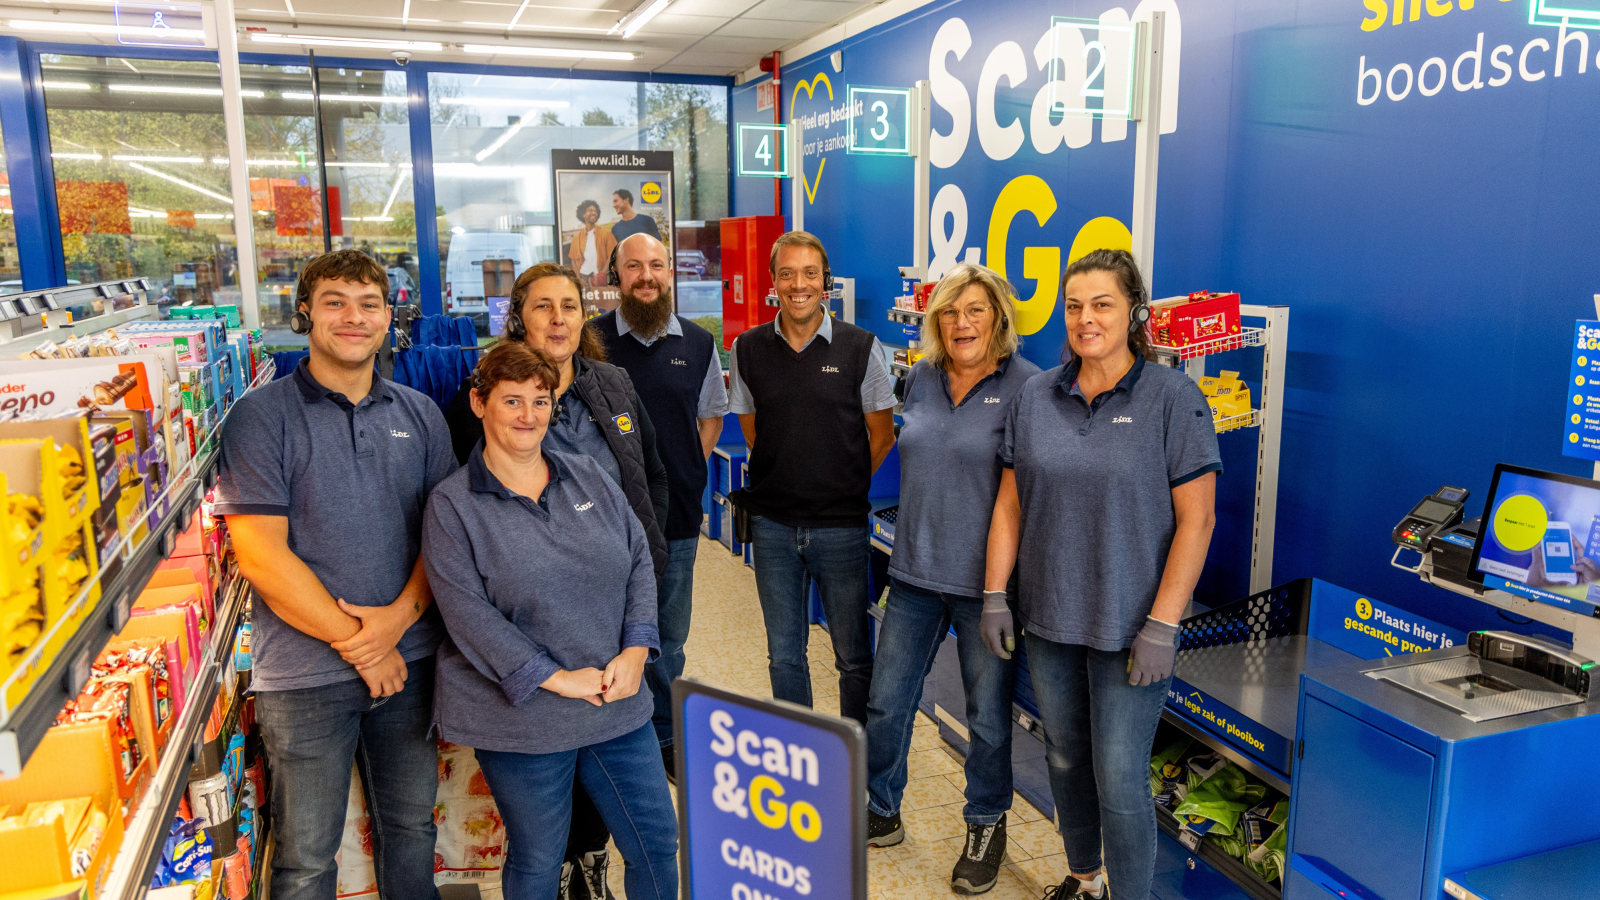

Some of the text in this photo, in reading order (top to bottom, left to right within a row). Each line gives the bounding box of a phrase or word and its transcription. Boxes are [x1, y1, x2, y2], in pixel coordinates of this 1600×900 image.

[929, 0, 1181, 168] Scan
[1080, 41, 1107, 97] 2
[801, 111, 817, 130] Heel
[818, 111, 830, 129] erg
[870, 101, 889, 141] 3
[579, 154, 646, 167] www.lidl.be
[755, 135, 771, 166] 4
[817, 138, 824, 157] je
[0, 383, 26, 394] der
[1344, 617, 1399, 646] gescande
[1360, 603, 1454, 649] 3. Plaats hier je
[1176, 692, 1184, 703] je
[1184, 696, 1201, 714] lege
[1202, 709, 1216, 723] zak
[1217, 719, 1226, 728] of
[1226, 723, 1265, 752] plooibox
[710, 710, 819, 787] Scan
[712, 761, 822, 842] &Go
[721, 838, 812, 895] CARDS
